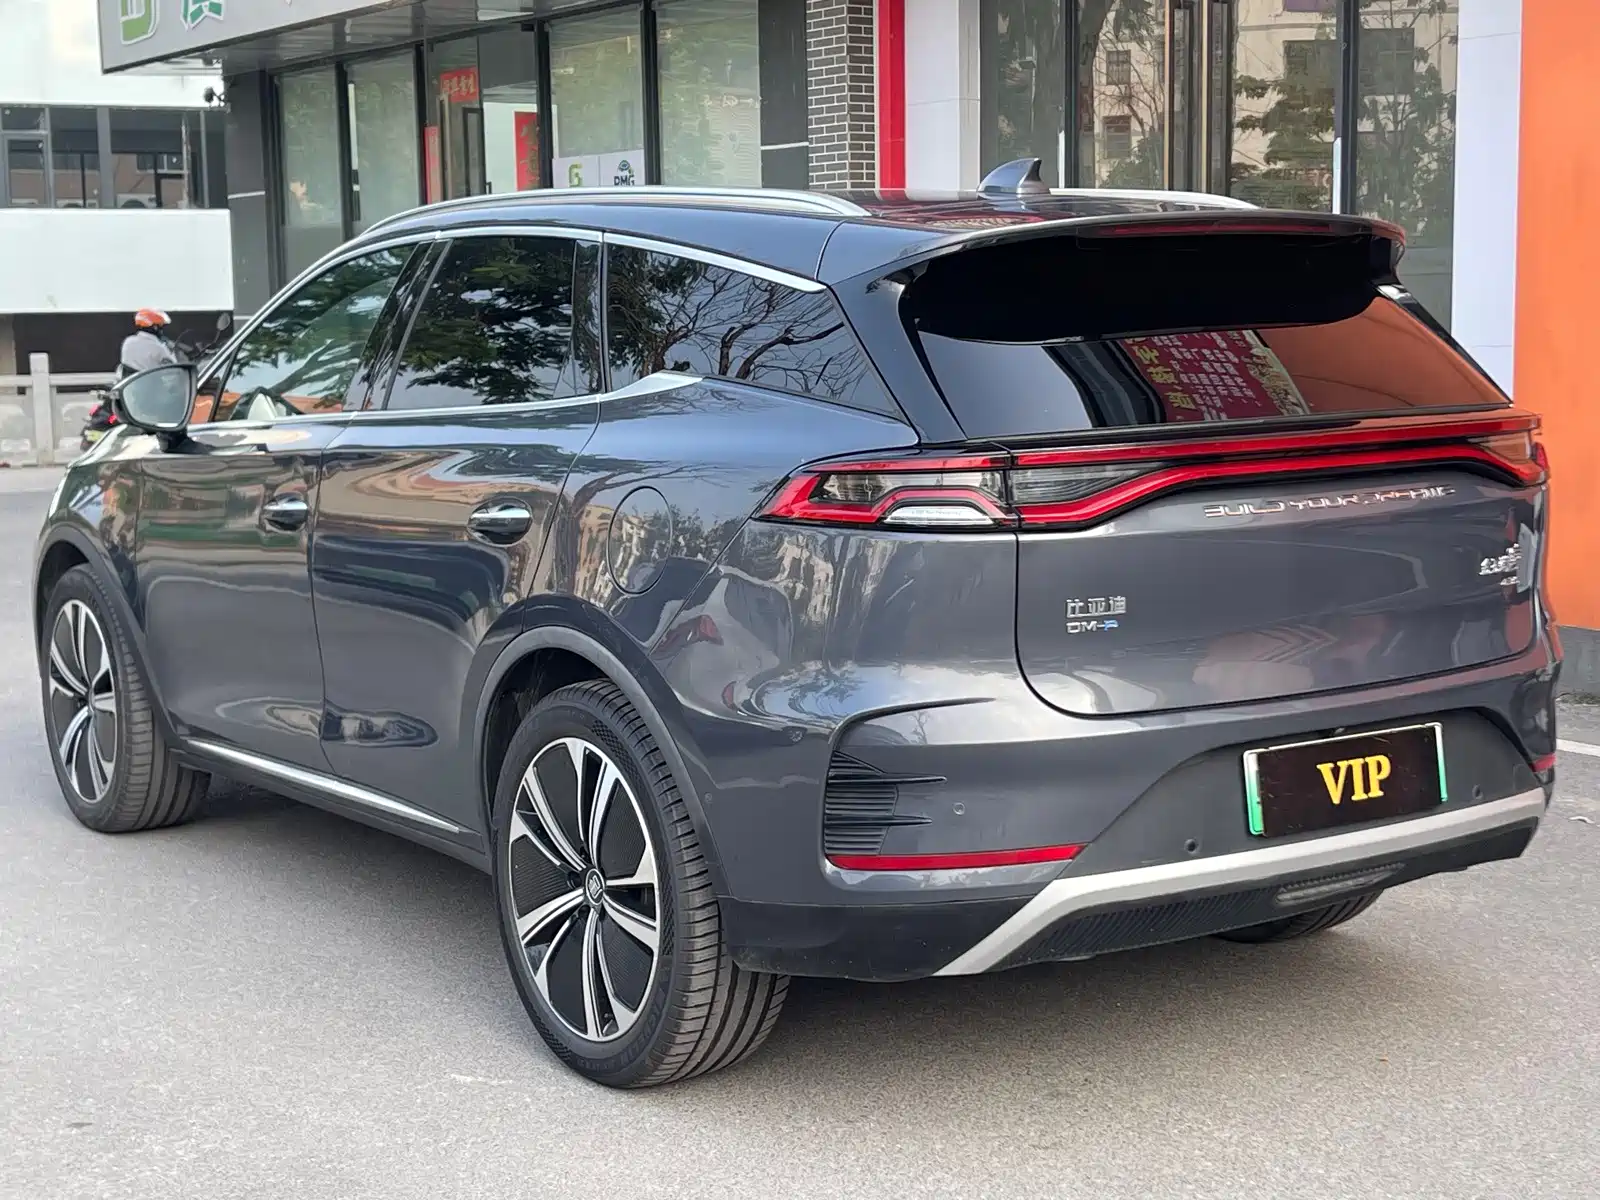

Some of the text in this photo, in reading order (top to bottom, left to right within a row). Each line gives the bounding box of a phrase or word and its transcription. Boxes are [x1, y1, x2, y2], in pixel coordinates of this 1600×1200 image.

[1289, 494, 1359, 511] YOUR
[1066, 595, 1126, 618] 比亚迪
[1316, 754, 1391, 805] VIP
